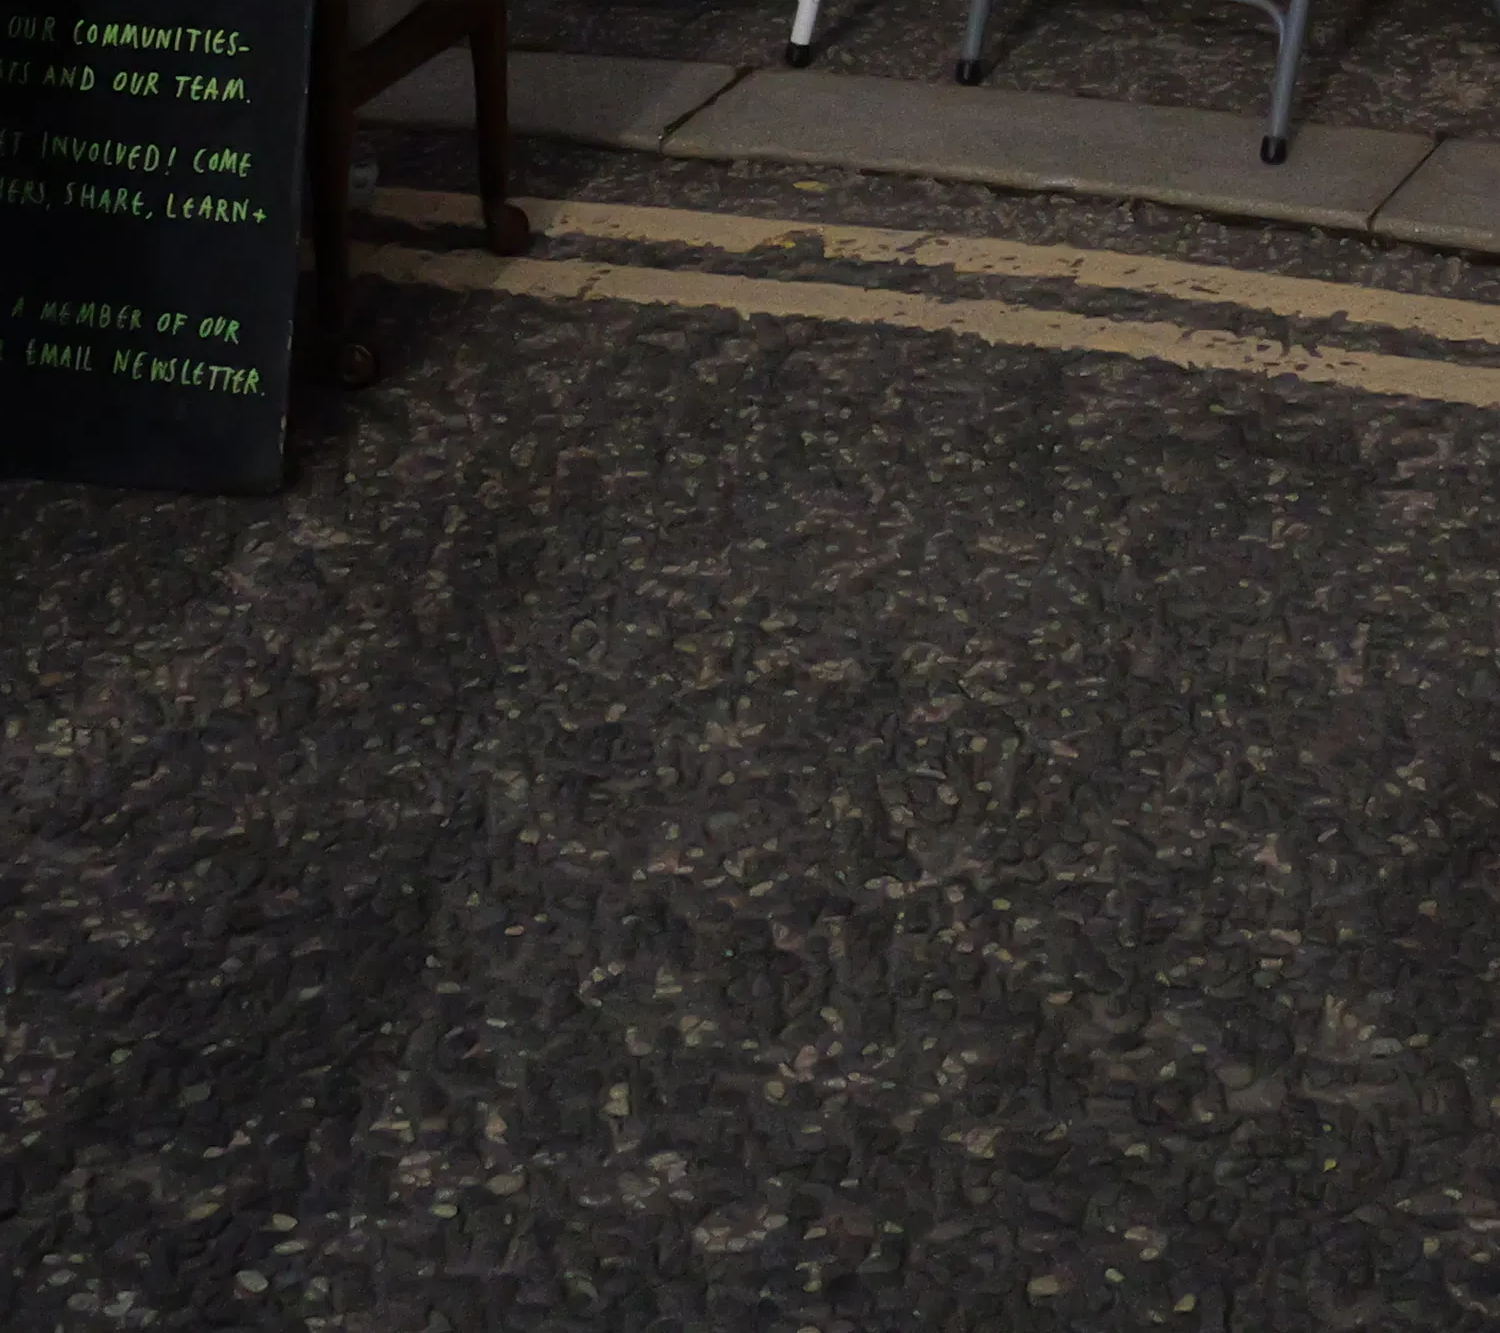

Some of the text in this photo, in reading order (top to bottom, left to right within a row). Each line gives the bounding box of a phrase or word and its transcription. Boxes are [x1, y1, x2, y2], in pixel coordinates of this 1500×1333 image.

[43, 64, 95, 92] AND
[112, 71, 159, 97] OUR
[176, 75, 252, 104] TEAM.
[41, 131, 177, 176] INVOLVED!
[192, 147, 253, 178] COME
[64, 182, 154, 221] SHARE,
[12, 295, 25, 318] A
[40, 300, 145, 331] MEMBER
[156, 312, 188, 336] OF
[198, 315, 243, 345] OUR
[25, 338, 93, 372] EMAIL
[112, 349, 266, 397] NEWSLETTER.
